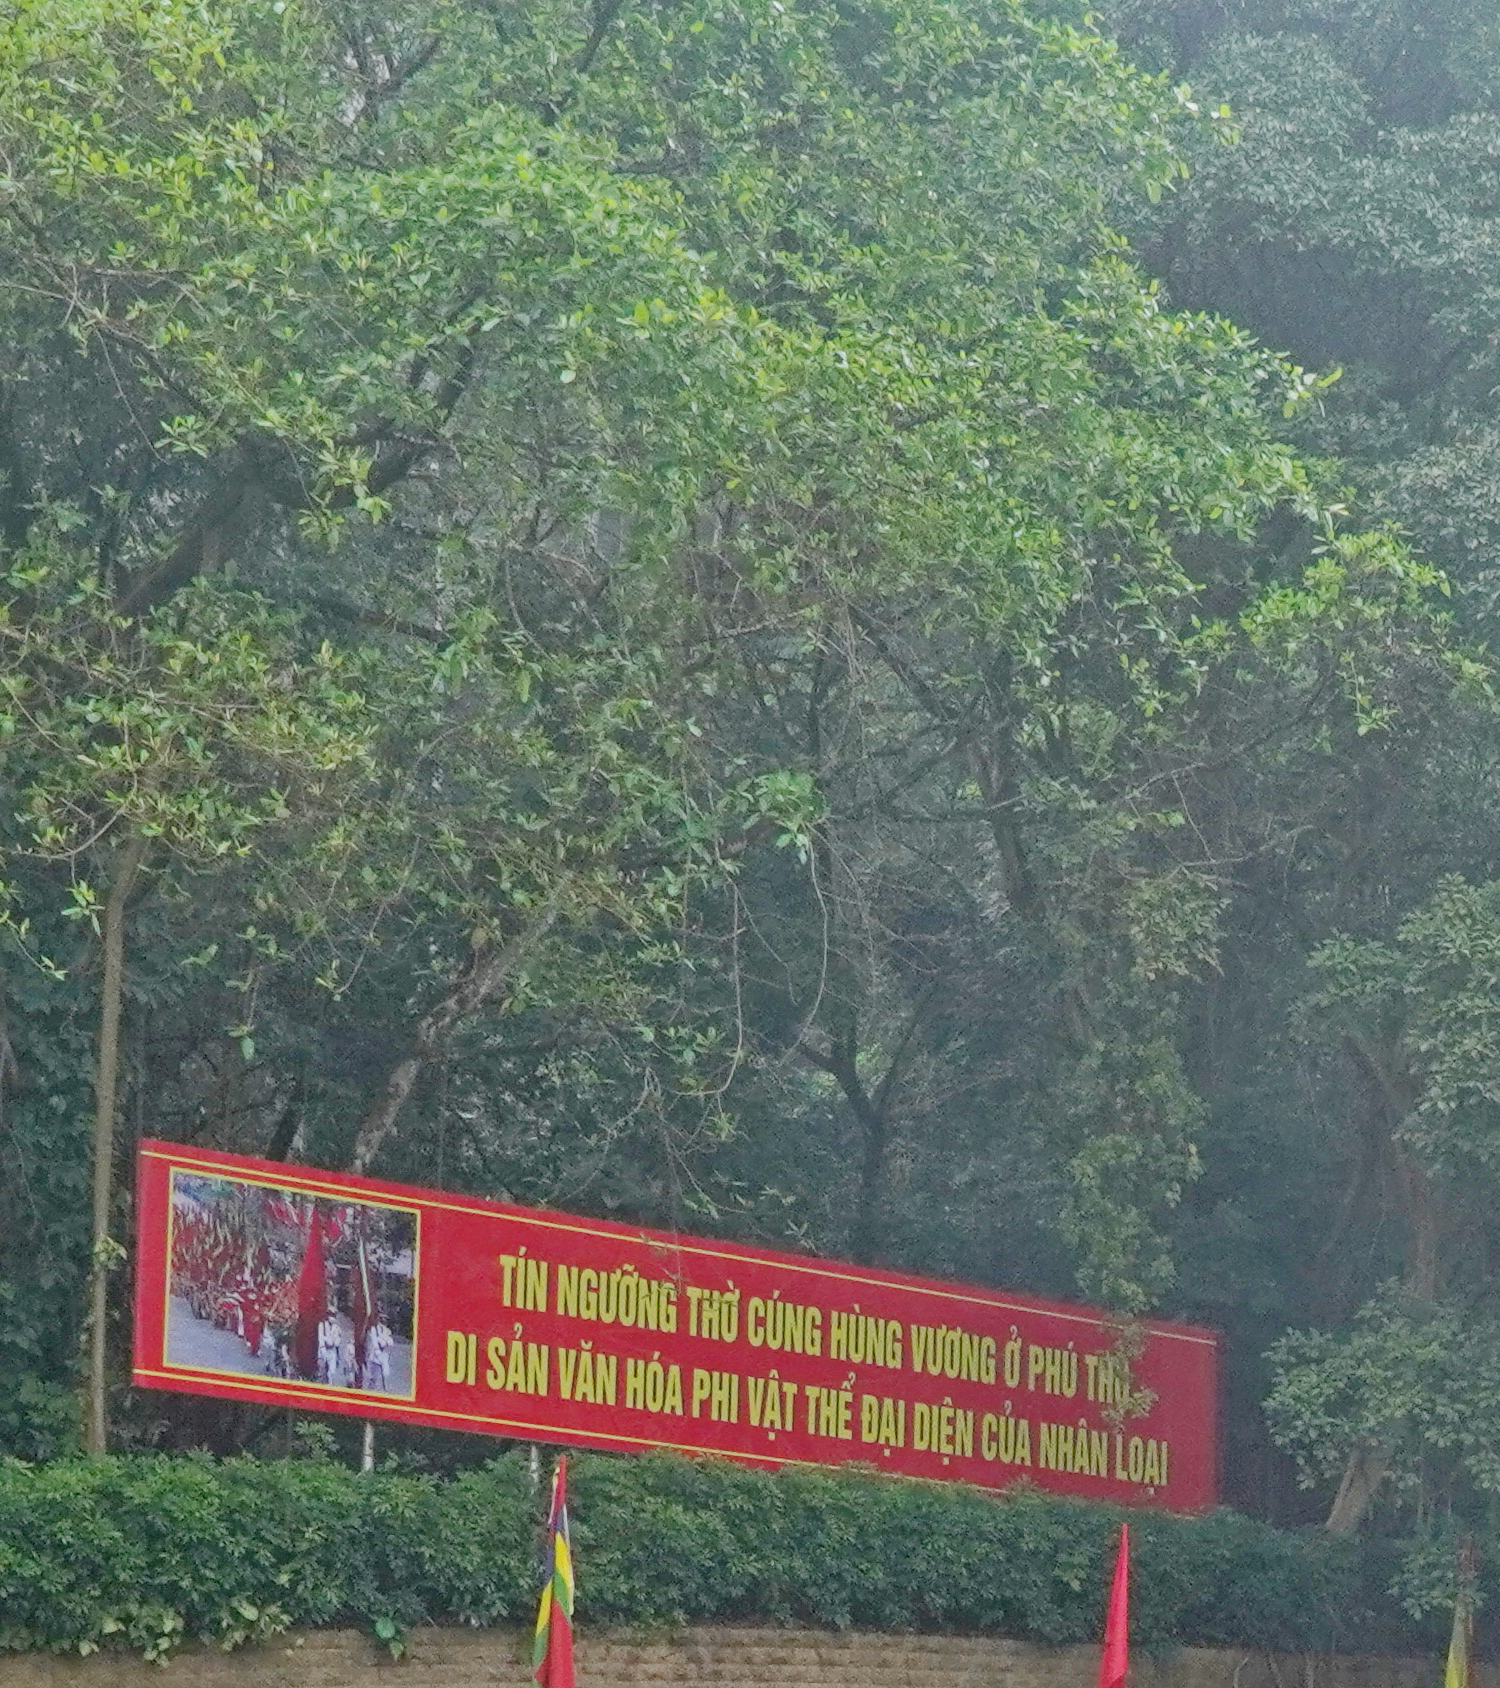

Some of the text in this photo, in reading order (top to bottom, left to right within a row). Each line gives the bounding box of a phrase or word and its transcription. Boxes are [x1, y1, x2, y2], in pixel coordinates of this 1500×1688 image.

[500, 1246, 548, 1312] TÍN
[557, 1264, 678, 1333] NGƯỠNG
[686, 1280, 740, 1343] THỜ
[747, 1290, 822, 1356] CÚNG
[831, 1304, 903, 1370] HÙNG
[911, 1323, 996, 1385] VƯƠNG
[1005, 1325, 1022, 1388] Ở
[1029, 1341, 1078, 1398] PHÚ
[446, 1323, 1168, 1495] DI SẢN VĂN HÓA PHI VẬT THỂ ĐẠI DIỆN CỦA NHÂN LOẠI
